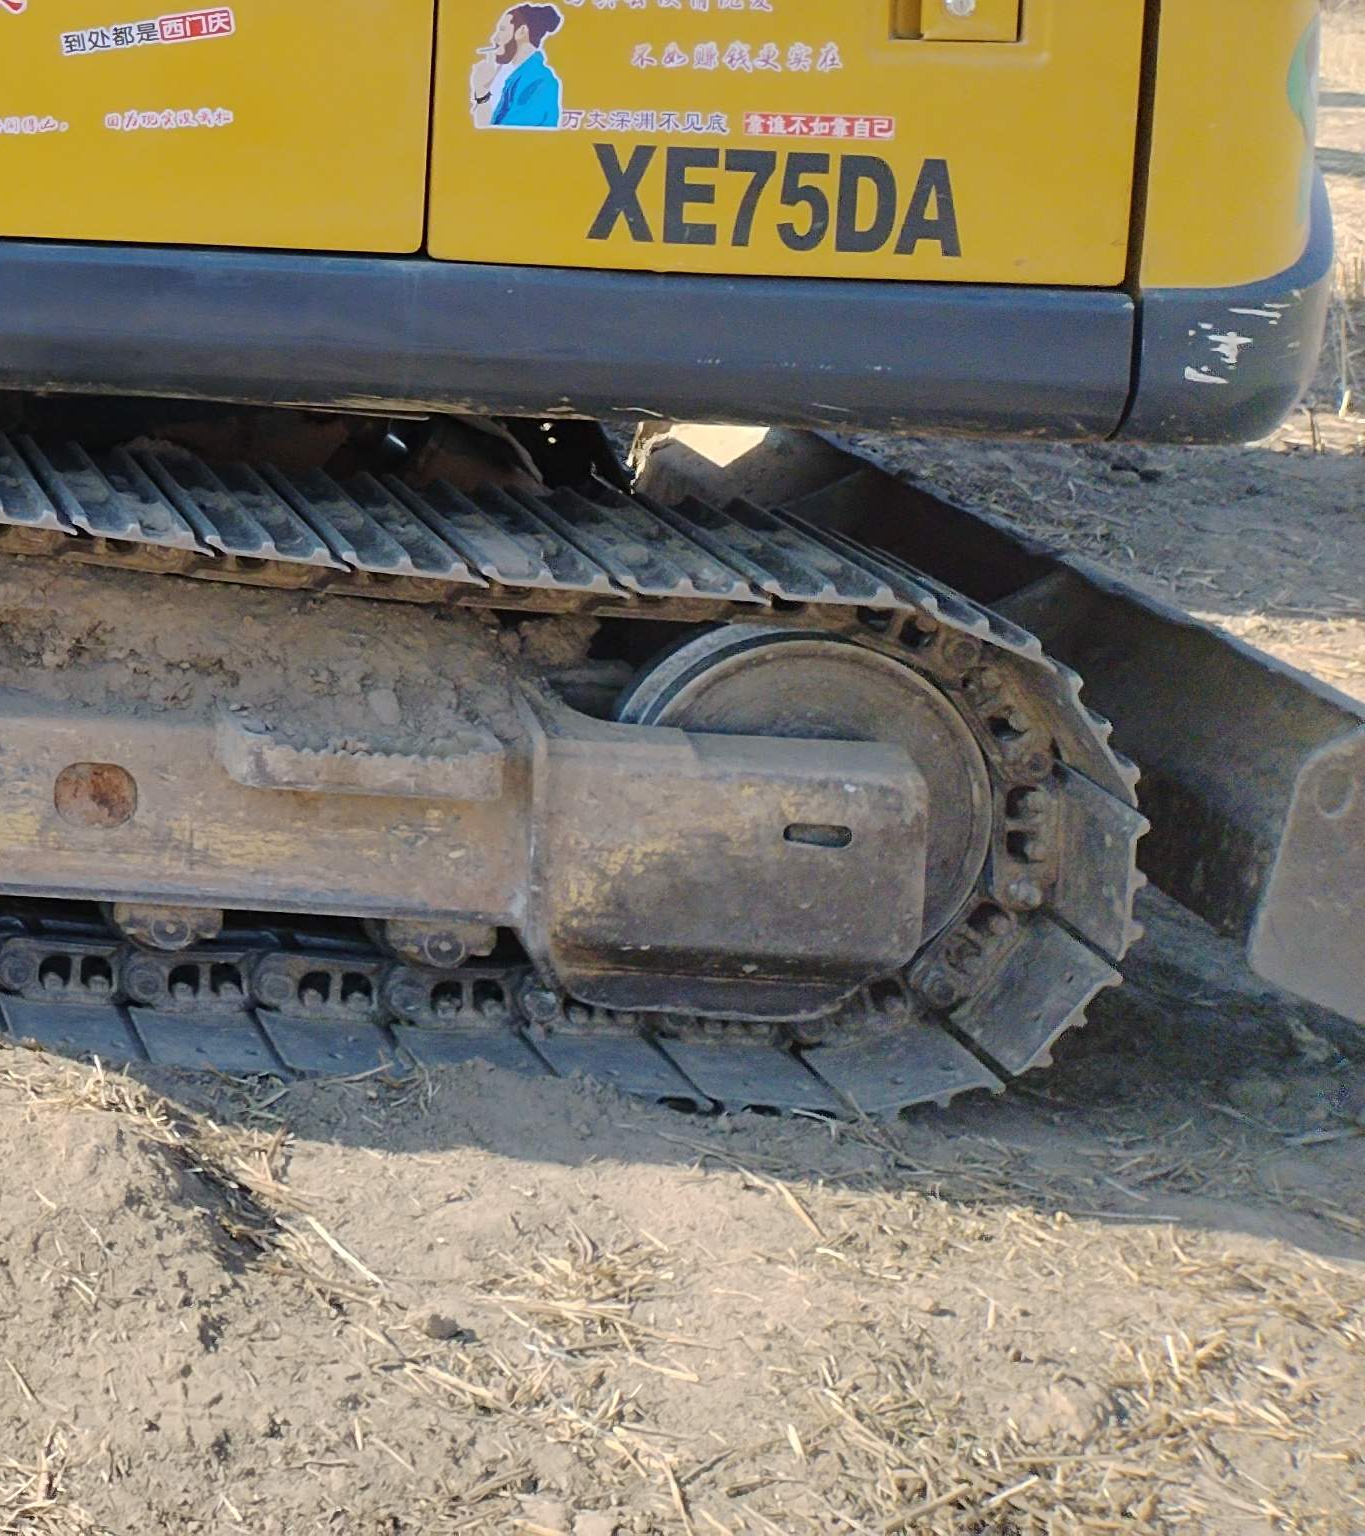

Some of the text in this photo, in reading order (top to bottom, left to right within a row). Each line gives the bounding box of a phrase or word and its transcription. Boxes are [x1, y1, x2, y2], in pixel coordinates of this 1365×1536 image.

[62, 8, 235, 56] 到处都是西门庆
[630, 42, 843, 72] 不如赚钱更实在
[561, 110, 895, 139] 万丈深渊不见底 靠谁不如靠自己
[586, 142, 963, 258] XE75DA
